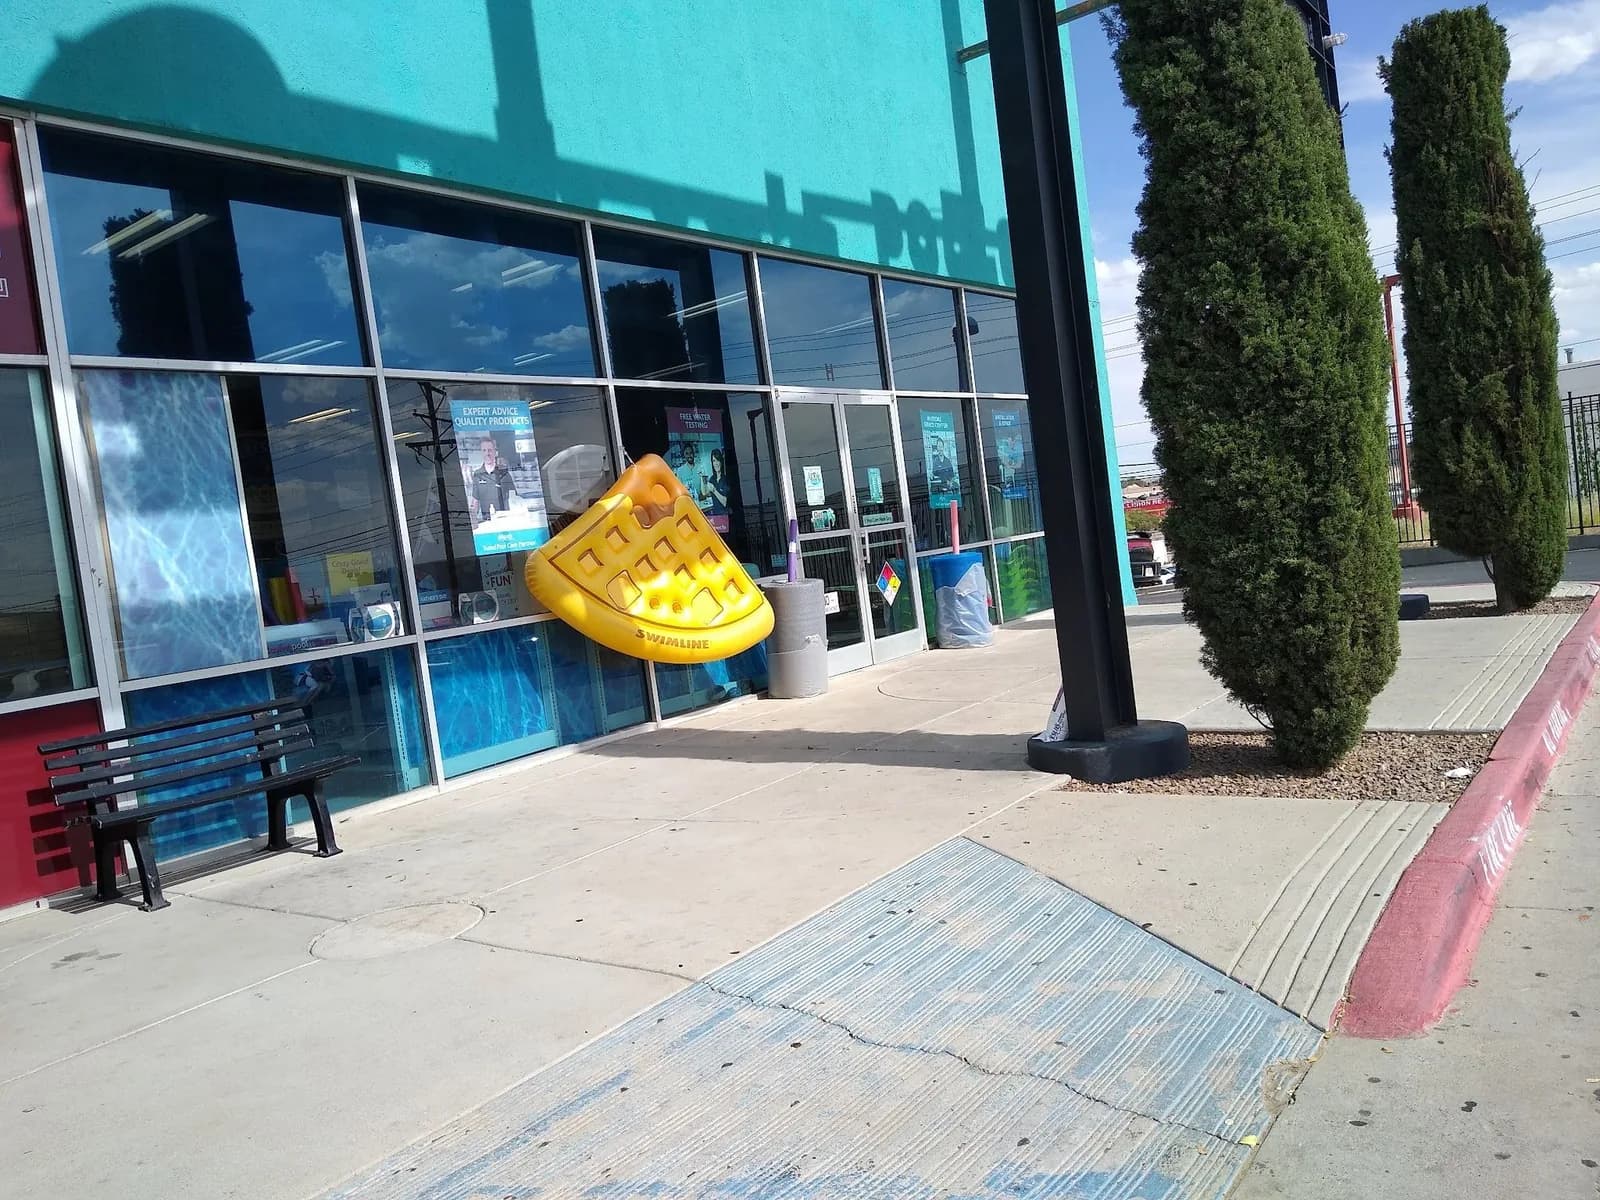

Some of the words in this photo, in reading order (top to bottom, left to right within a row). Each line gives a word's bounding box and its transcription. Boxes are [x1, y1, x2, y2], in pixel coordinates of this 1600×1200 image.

[463, 407, 490, 416] EXPERT
[492, 407, 519, 416] ADVICE
[454, 417, 488, 427] QUALITY
[489, 416, 530, 425] PRODUCTS
[679, 412, 693, 421] FREE
[693, 413, 712, 422] WATER
[685, 421, 708, 430] TESTING
[491, 574, 511, 588] FUN
[635, 628, 710, 649] SWIMLINE
